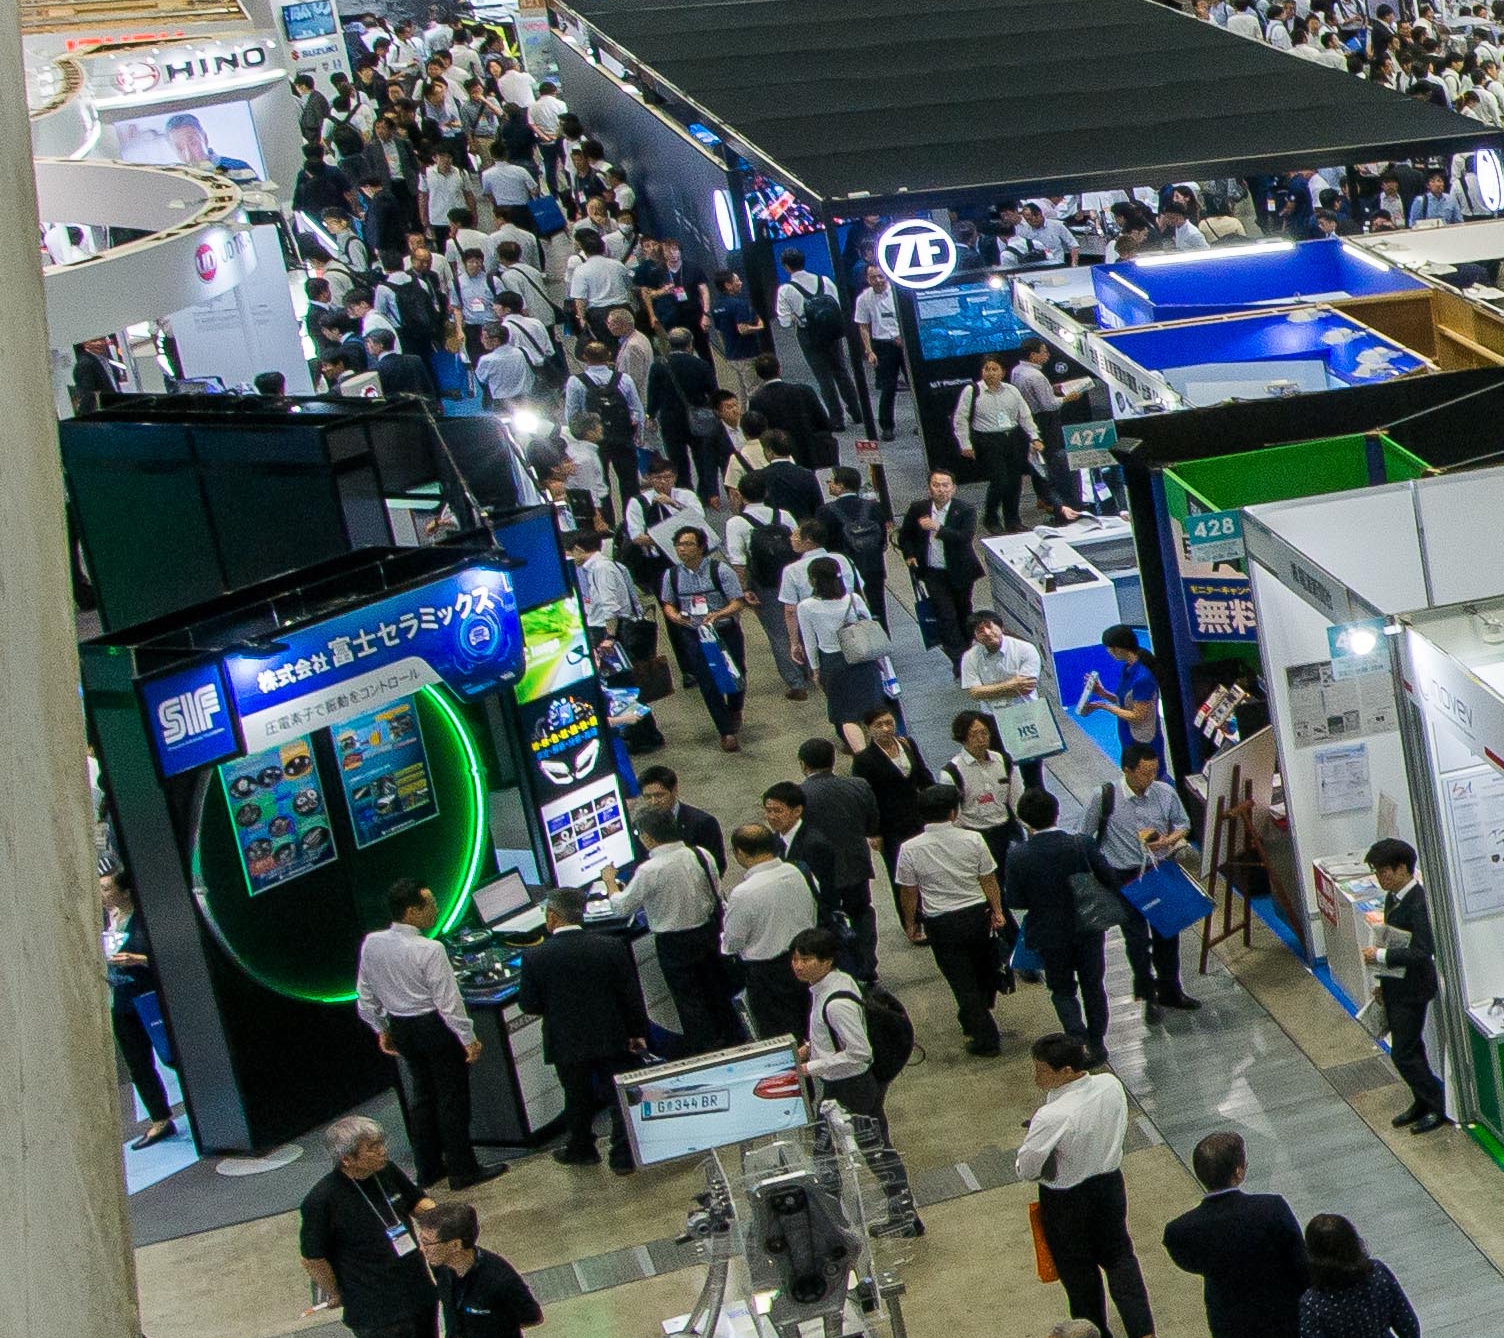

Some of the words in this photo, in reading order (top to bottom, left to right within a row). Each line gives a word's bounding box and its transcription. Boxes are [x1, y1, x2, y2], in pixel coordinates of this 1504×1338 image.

[166, 47, 265, 83] HINO
[883, 235, 941, 277] ZF
[1070, 428, 1106, 447] 427
[1194, 516, 1235, 538] 428
[257, 585, 496, 694] 株式会社富士セラミックス
[264, 668, 421, 738] 圧電素子で振動をコントロール
[674, 1097, 699, 1112] 344
[701, 1094, 719, 1107] BR
